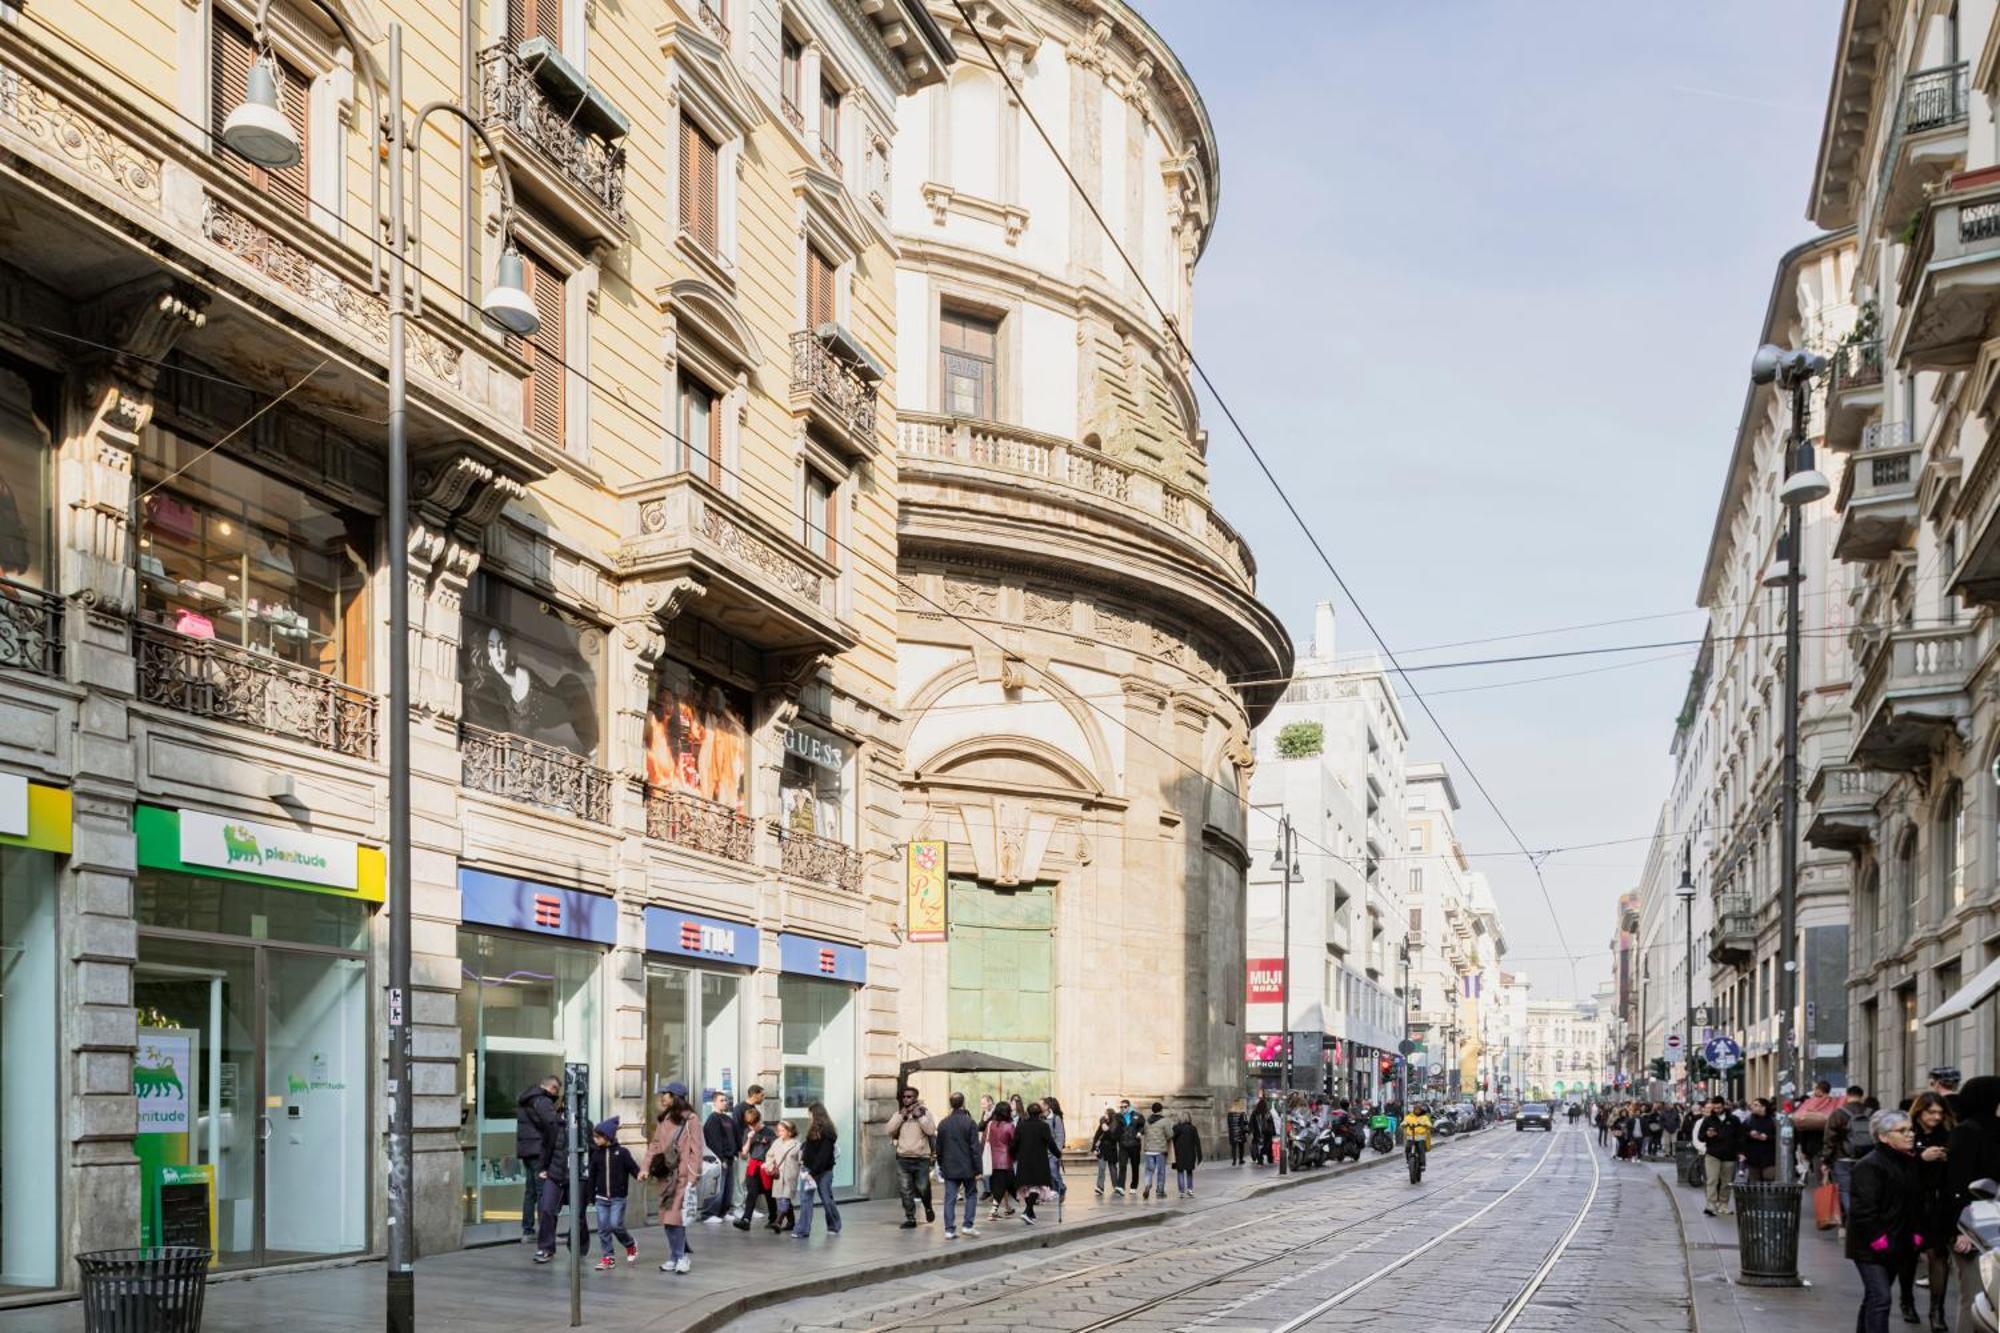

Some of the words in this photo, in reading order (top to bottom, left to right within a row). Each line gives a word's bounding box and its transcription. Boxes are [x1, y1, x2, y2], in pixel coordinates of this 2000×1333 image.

[784, 728, 842, 769] GUESS
[265, 848, 327, 868] plenitude
[701, 925, 735, 955] TIM
[1250, 970, 1282, 985] MUJI
